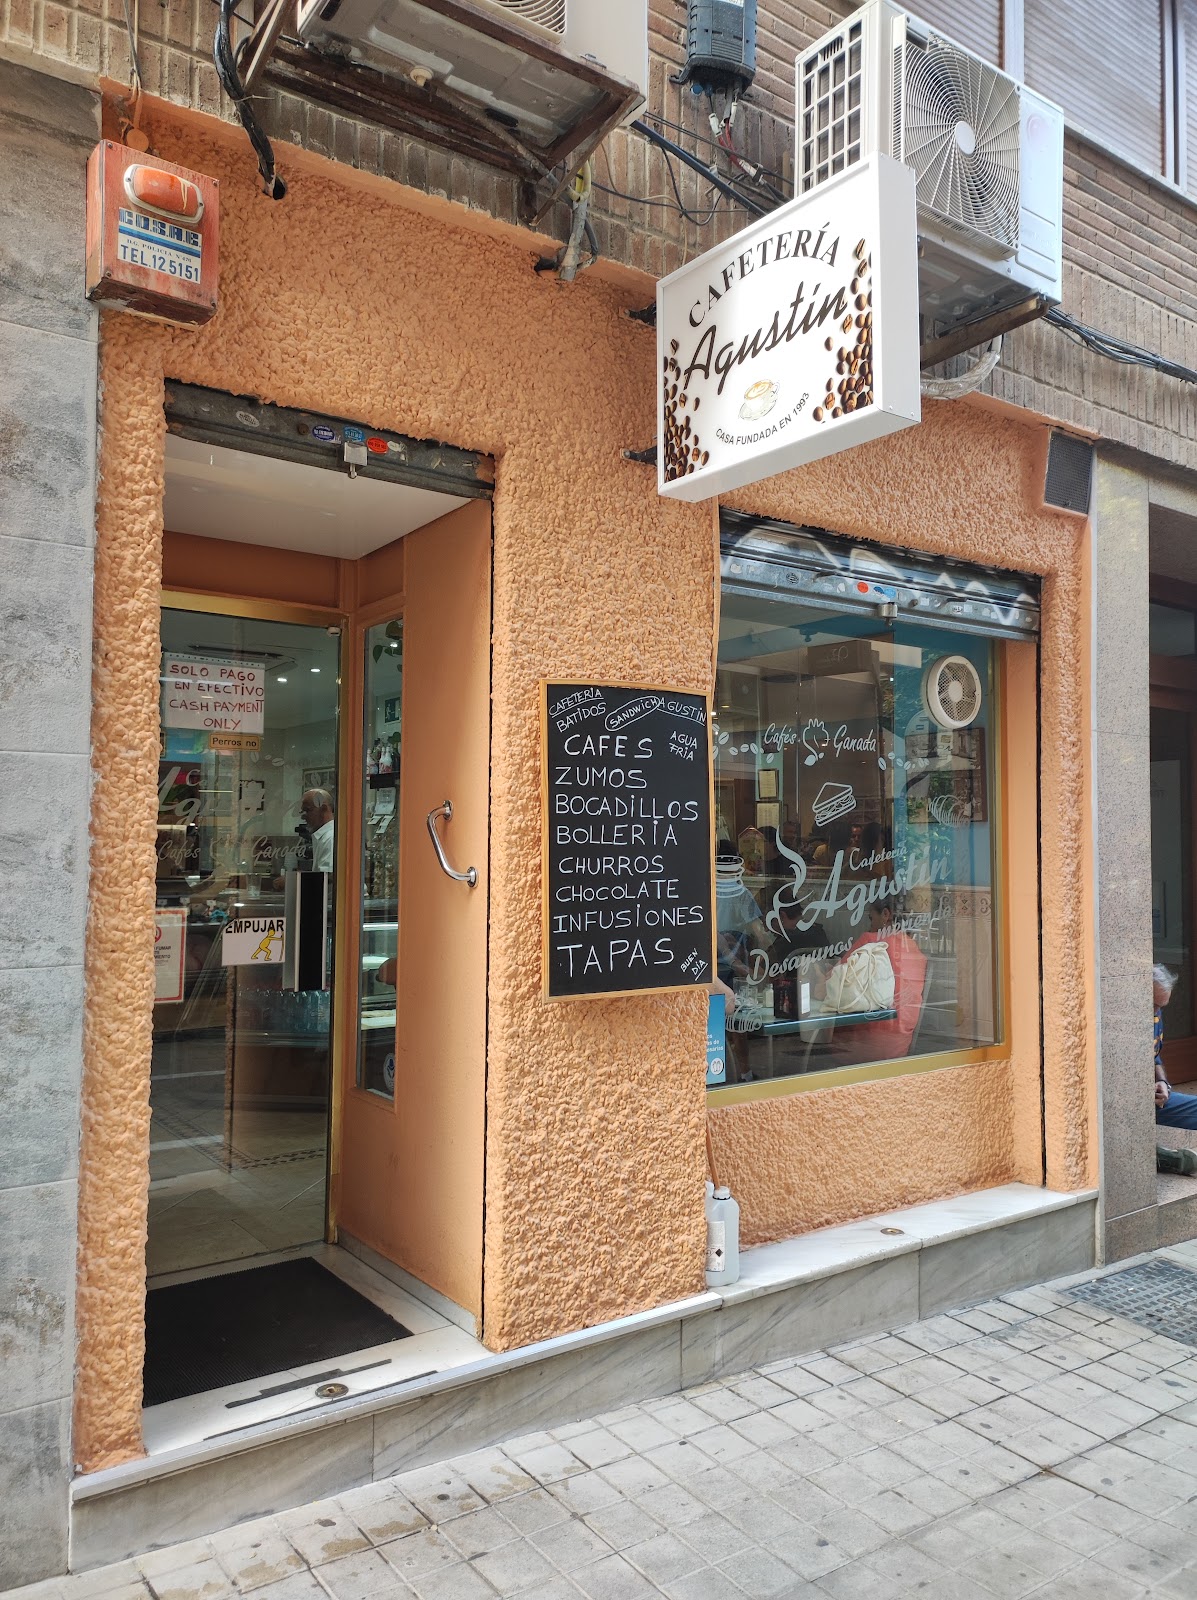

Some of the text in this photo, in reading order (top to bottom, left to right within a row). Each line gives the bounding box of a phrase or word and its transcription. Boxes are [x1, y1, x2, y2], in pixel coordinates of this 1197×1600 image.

[689, 222, 840, 327] CAFETERÍA
[684, 281, 848, 395] Agustín
[716, 392, 810, 445] CASA FUNDADA EN 1993
[169, 664, 256, 682] SOLO PAGO
[174, 681, 190, 690] EN
[169, 699, 265, 713] CASH PAYMENT
[203, 717, 241, 730] ONLY
[212, 737, 242, 747] Perros
[670, 731, 698, 749] AGUA
[763, 723, 877, 757] Cafés Ganada
[555, 767, 648, 789] ZUMOS
[558, 855, 664, 876] CHURROS
[555, 878, 680, 902] CHOCOLATE
[225, 919, 285, 934] EMPUJAR
[557, 938, 674, 978] TAPAS
[681, 948, 698, 972] BUEN
[746, 936, 854, 986] Desayunos
